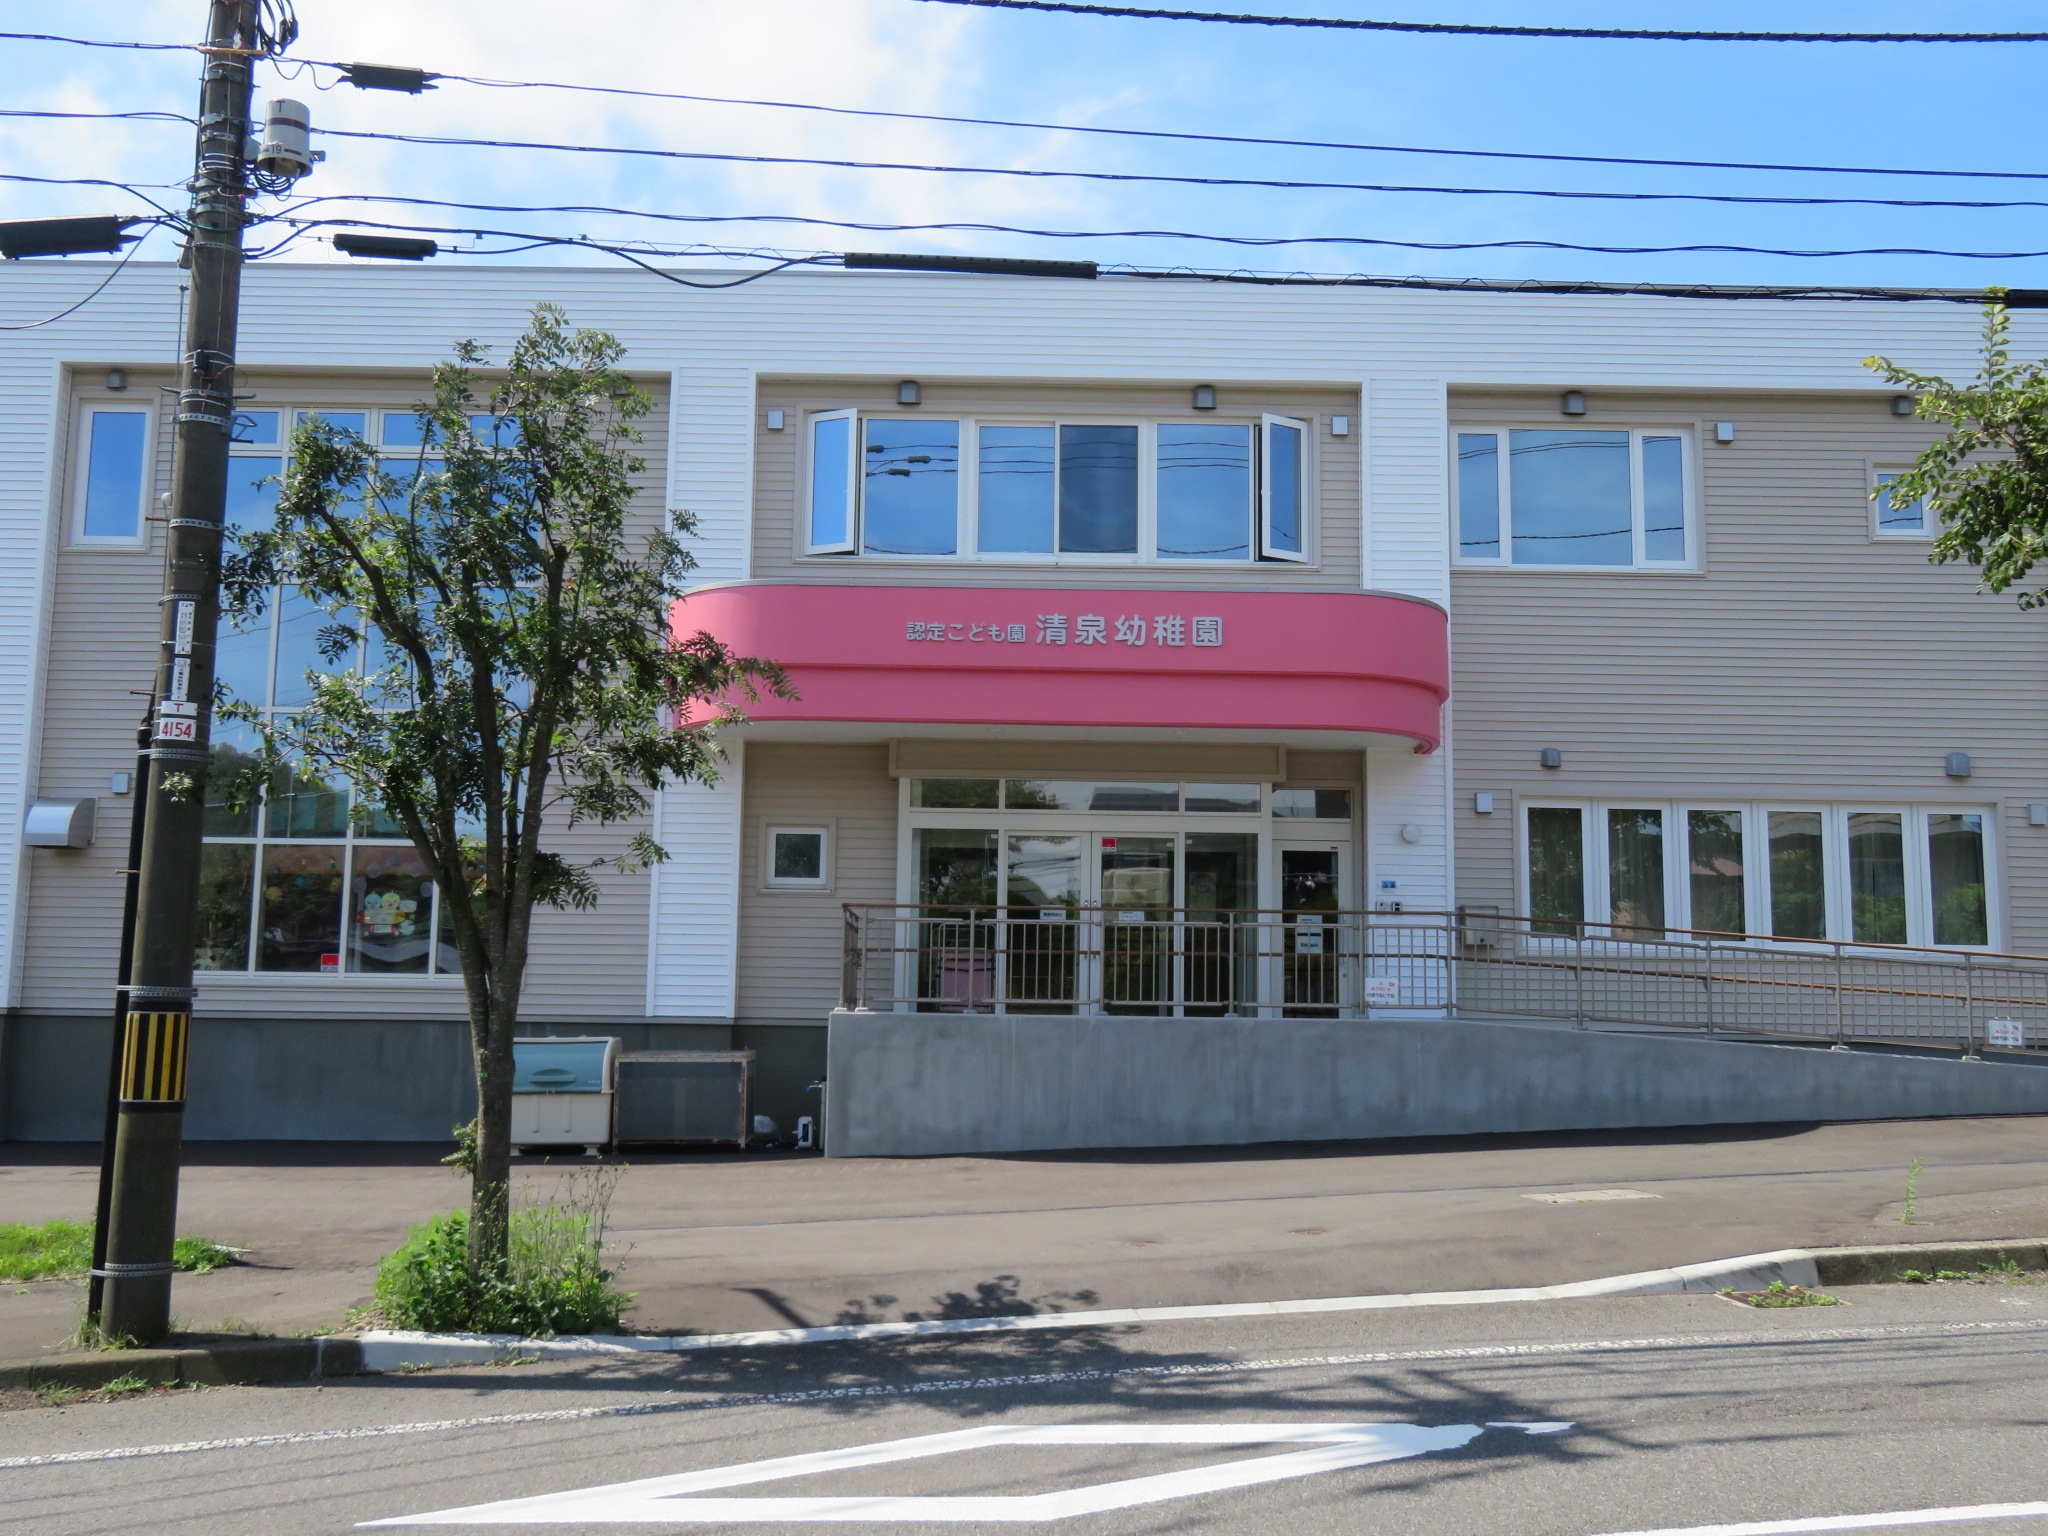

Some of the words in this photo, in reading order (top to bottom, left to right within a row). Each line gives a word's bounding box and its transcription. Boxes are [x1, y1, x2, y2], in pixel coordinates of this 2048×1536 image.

[276, 100, 285, 112] T
[272, 145, 282, 154] 19
[906, 621, 1026, 643] 認定こども園
[1035, 613, 1224, 647] 清泉幼稚園
[173, 703, 184, 713] T
[161, 721, 192, 738] 4154
